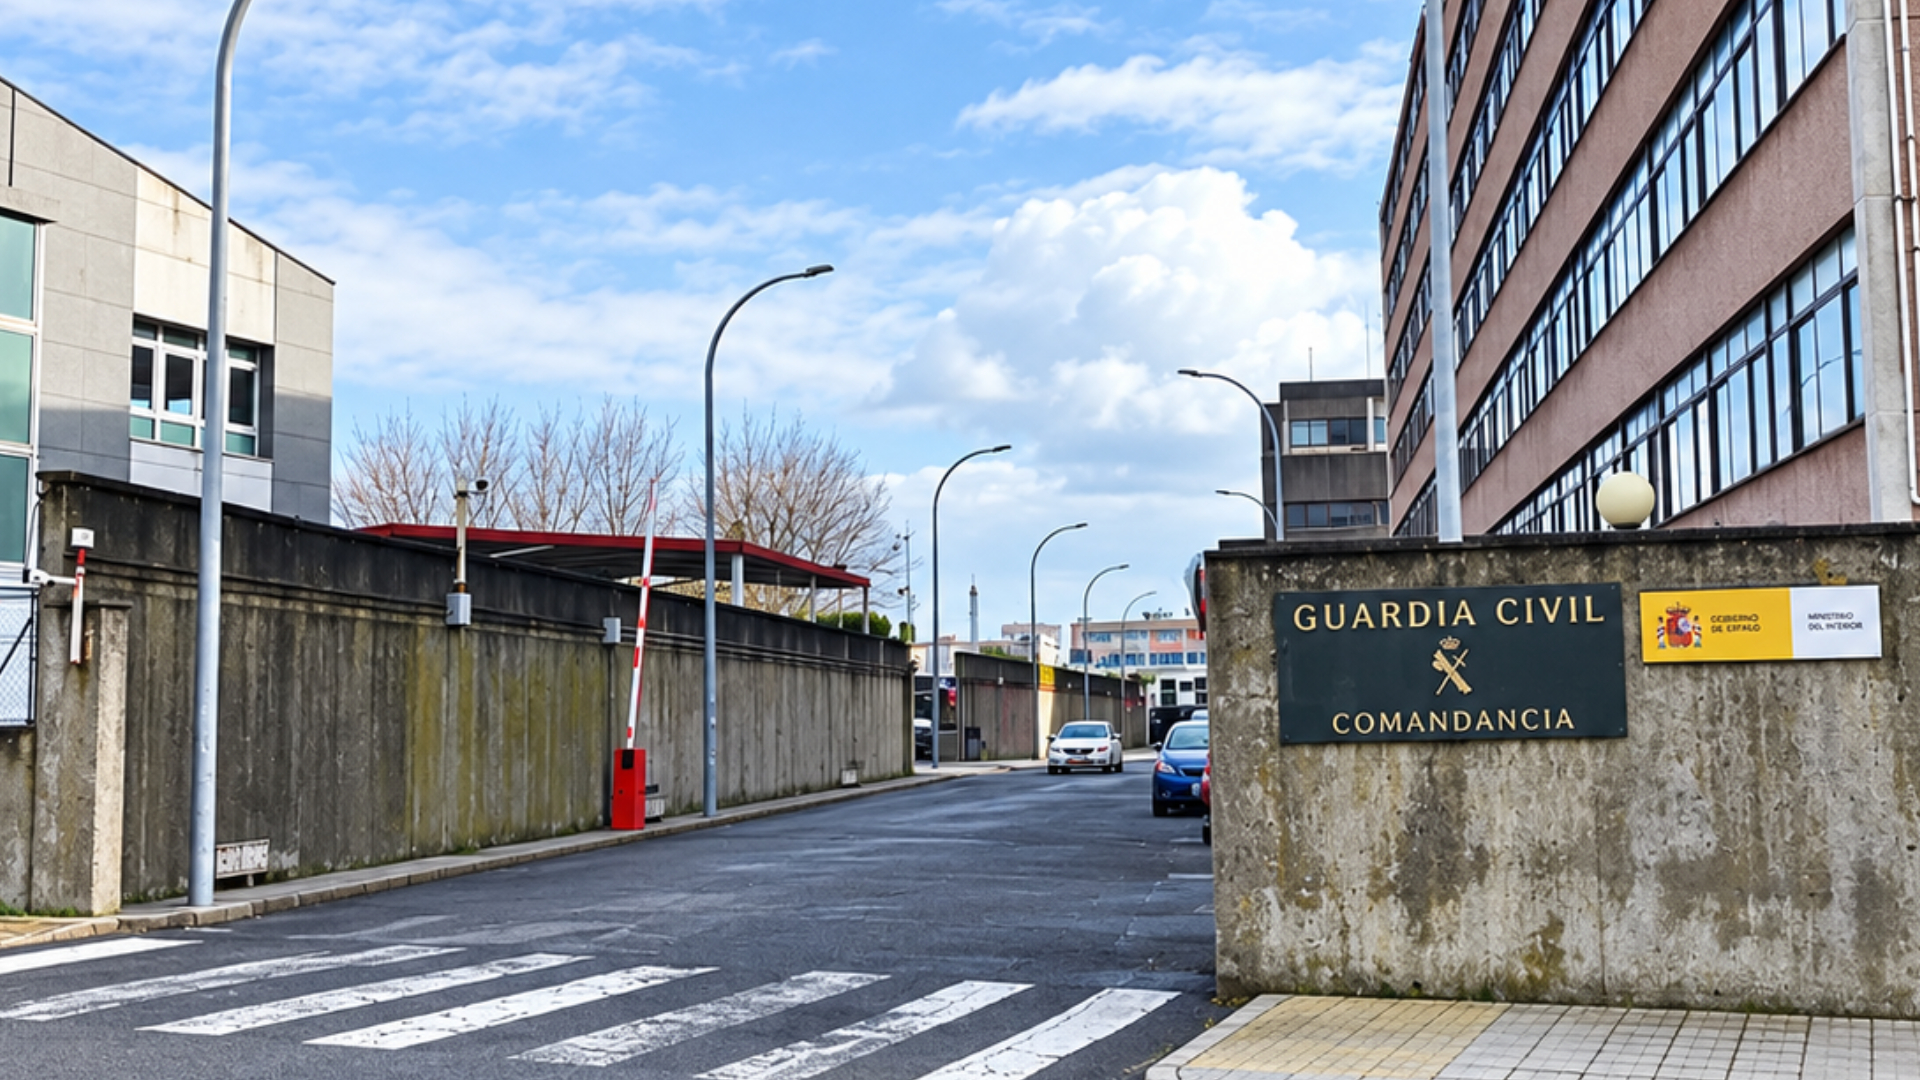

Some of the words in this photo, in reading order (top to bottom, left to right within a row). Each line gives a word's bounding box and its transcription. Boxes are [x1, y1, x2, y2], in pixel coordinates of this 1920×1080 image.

[1293, 599, 1476, 631] GUARDIA
[1496, 595, 1605, 625] CIVIL
[1332, 708, 1575, 735] COMANDANCIA
